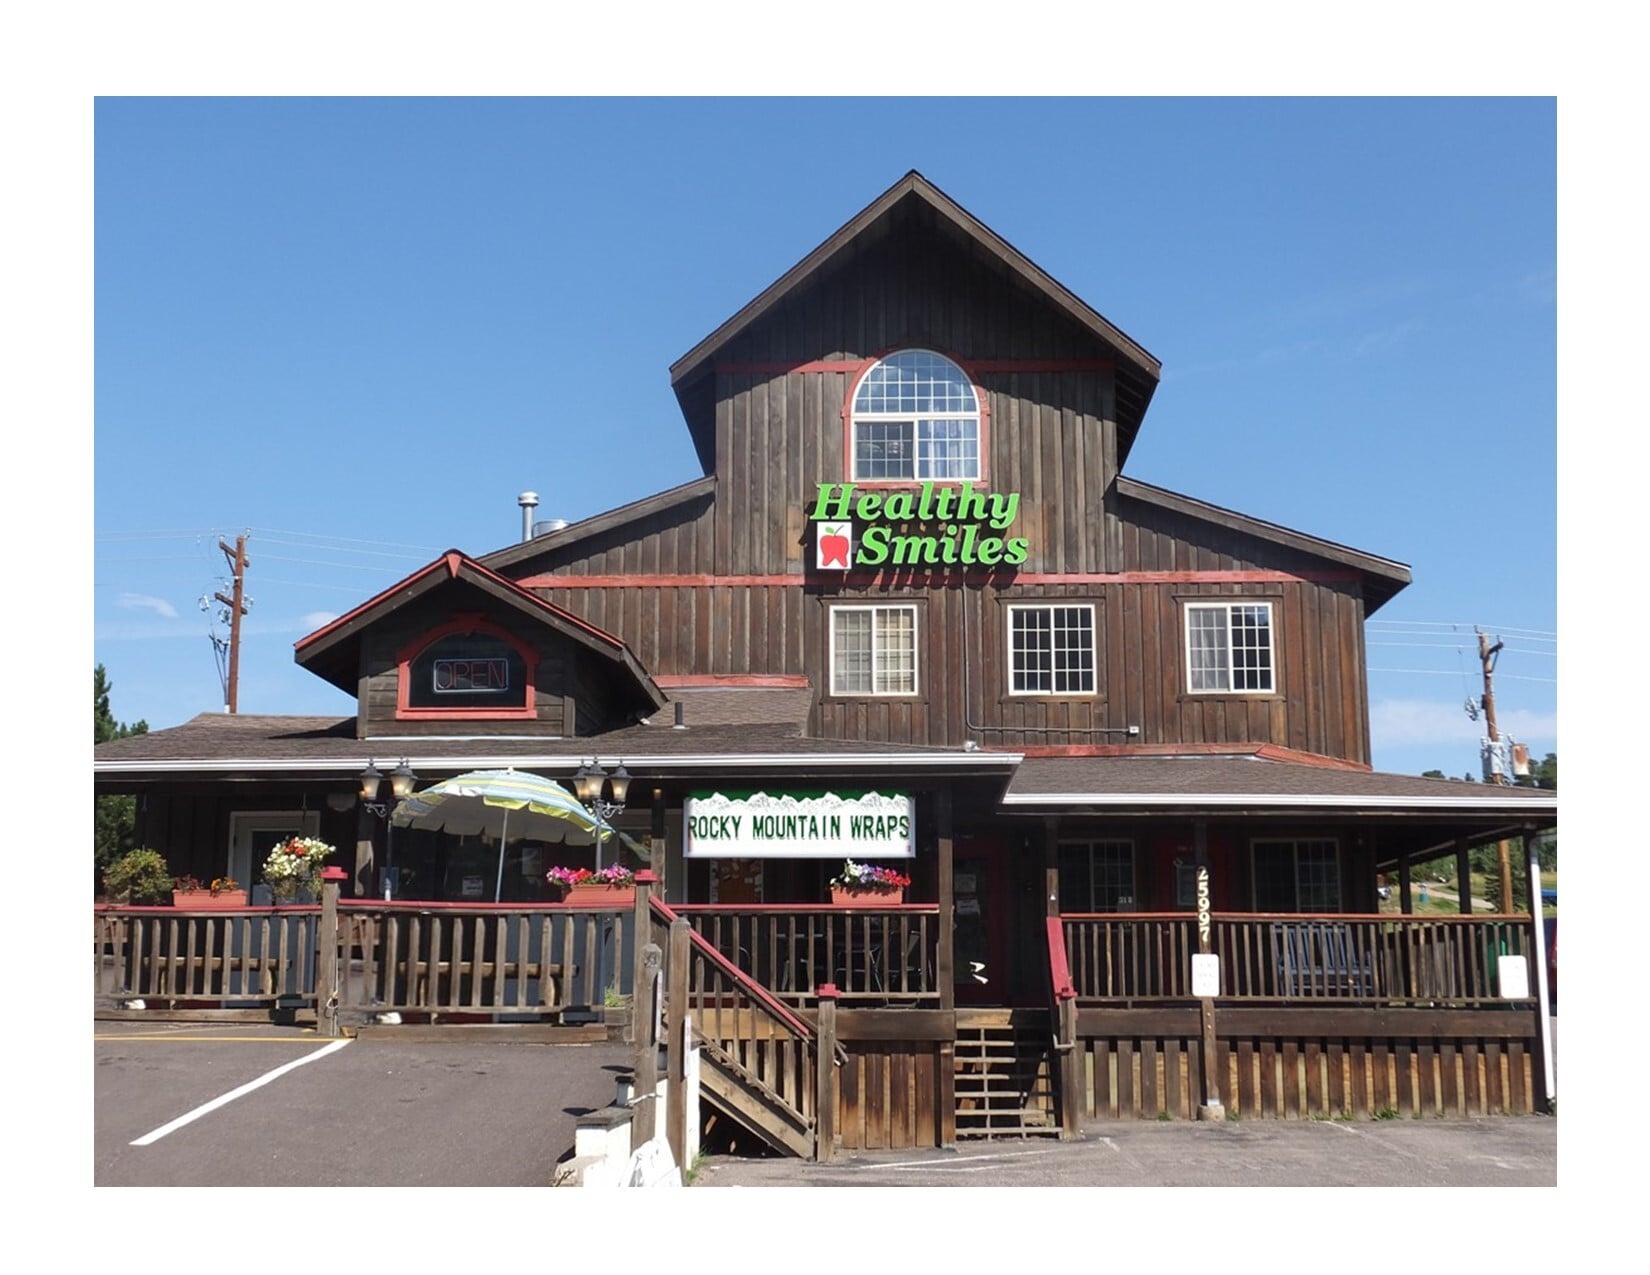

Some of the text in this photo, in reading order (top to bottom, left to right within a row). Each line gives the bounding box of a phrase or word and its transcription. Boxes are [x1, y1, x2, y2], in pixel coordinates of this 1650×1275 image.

[810, 481, 1020, 529] Healthy
[856, 525, 1030, 565] Smiles
[437, 661, 505, 689] OPEN
[689, 815, 909, 839] ROCKY MOUNTAIN WRAPS
[1198, 866, 1210, 942] 25997
